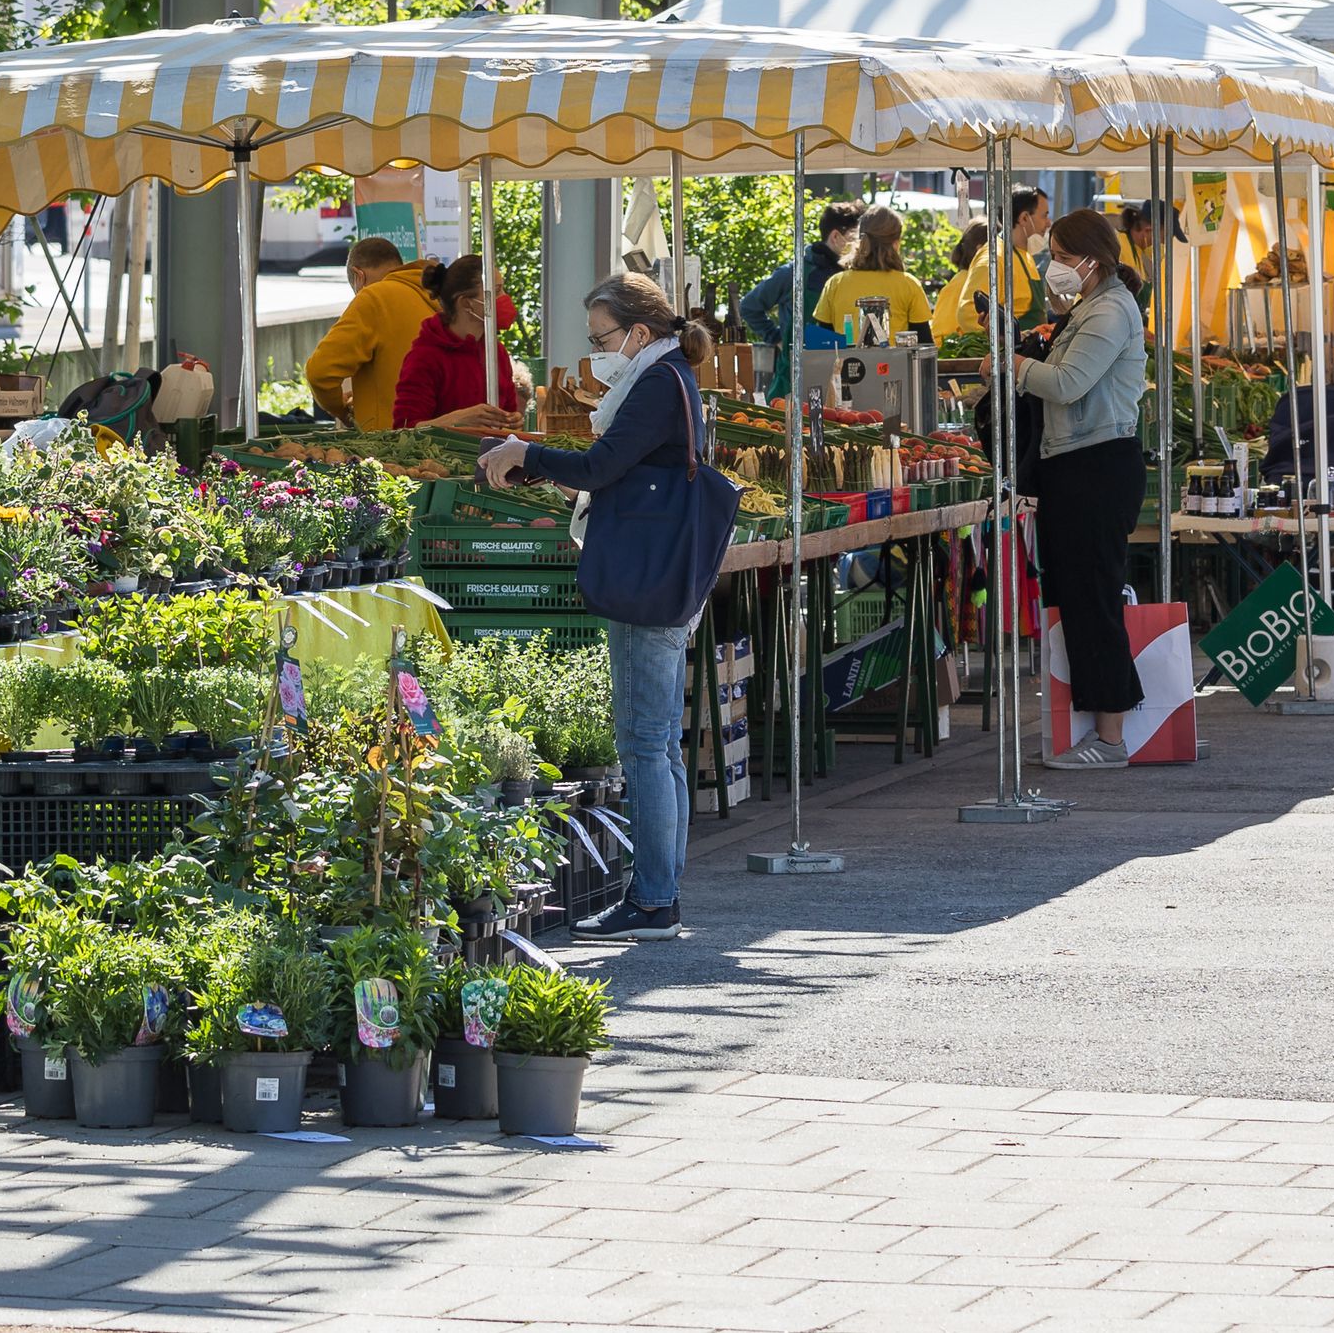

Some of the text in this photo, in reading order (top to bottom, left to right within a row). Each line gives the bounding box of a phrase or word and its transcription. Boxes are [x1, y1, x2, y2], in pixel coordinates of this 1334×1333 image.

[472, 541, 500, 550] FRISCHE
[466, 584, 499, 593] FRISCHE
[1256, 640, 1292, 674] PRODUKTE
